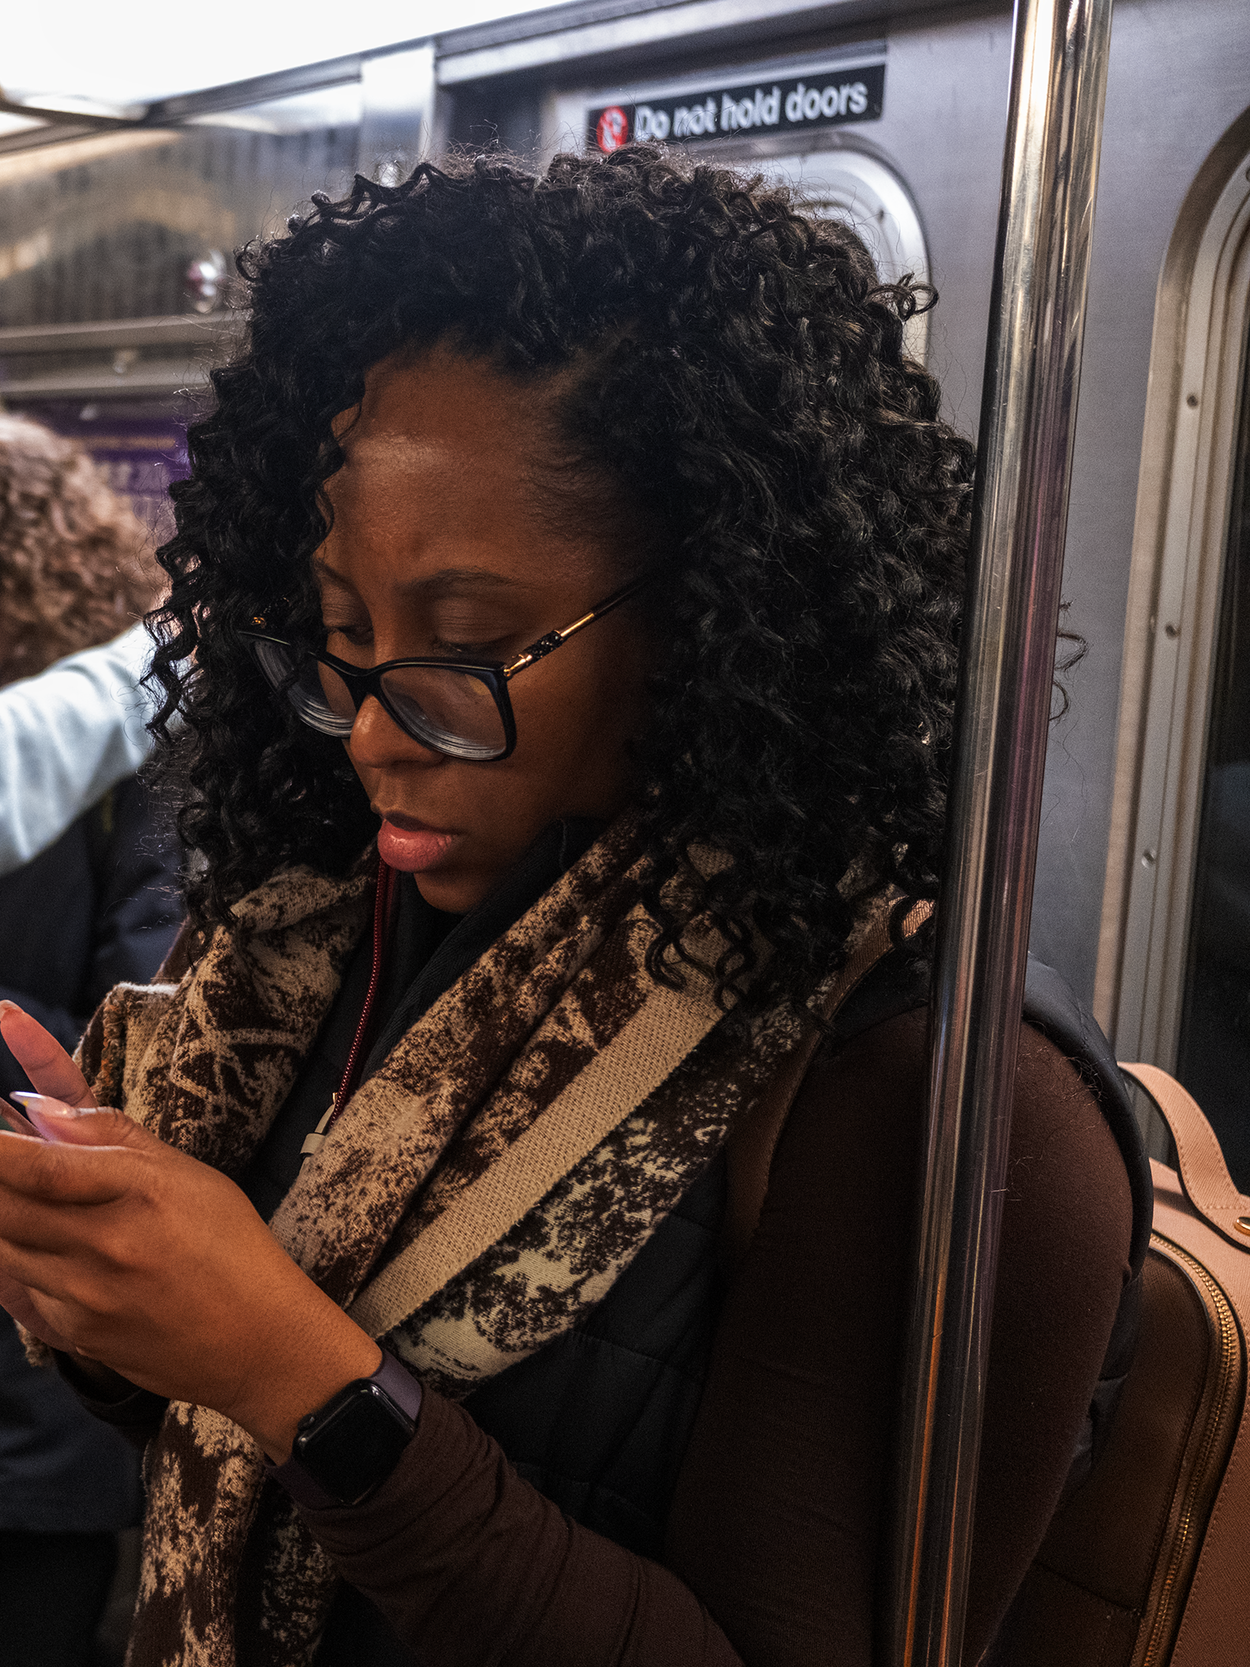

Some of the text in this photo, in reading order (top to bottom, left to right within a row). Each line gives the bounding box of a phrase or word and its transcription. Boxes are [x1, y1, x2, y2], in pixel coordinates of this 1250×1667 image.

[634, 82, 868, 141] Do not hold doors
